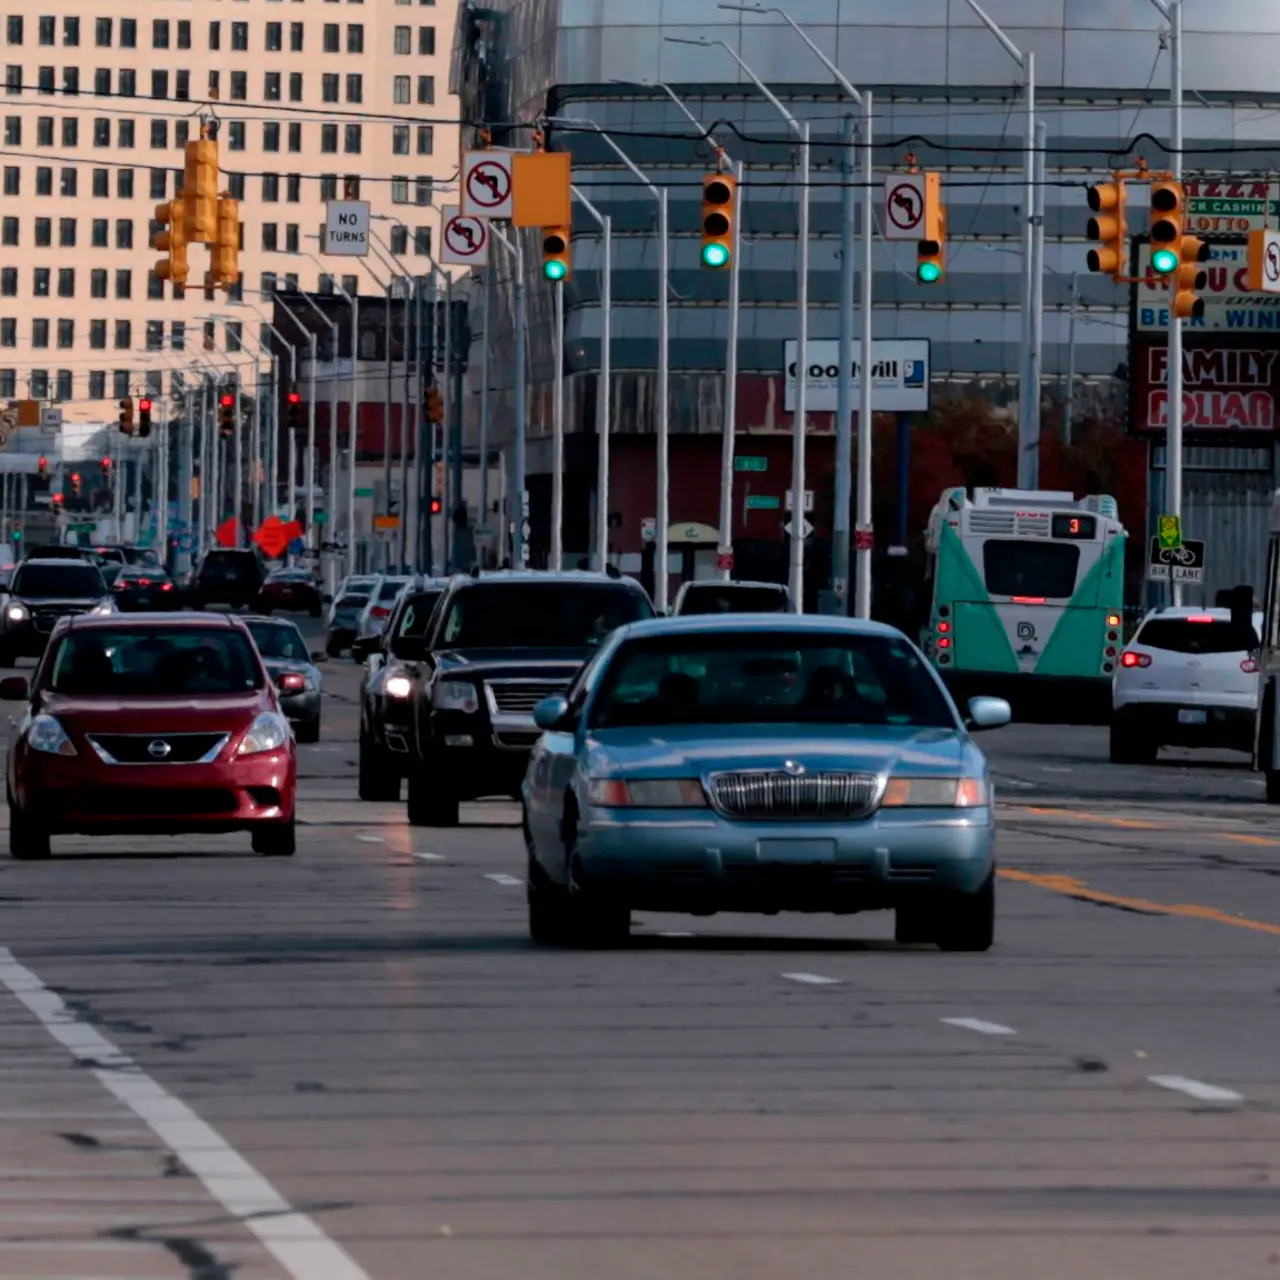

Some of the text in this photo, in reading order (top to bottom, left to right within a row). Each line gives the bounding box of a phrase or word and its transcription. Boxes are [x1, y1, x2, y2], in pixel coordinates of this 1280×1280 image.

[1183, 183, 1270, 199] IZZA
[339, 213, 358, 226] NO
[329, 230, 366, 243] TURNS
[1140, 308, 1206, 327] BER
[788, 360, 897, 378] ooill
[1148, 346, 1279, 386] FAMILY
[1147, 389, 1274, 429] DOLLAR
[1069, 518, 1079, 533] 3
